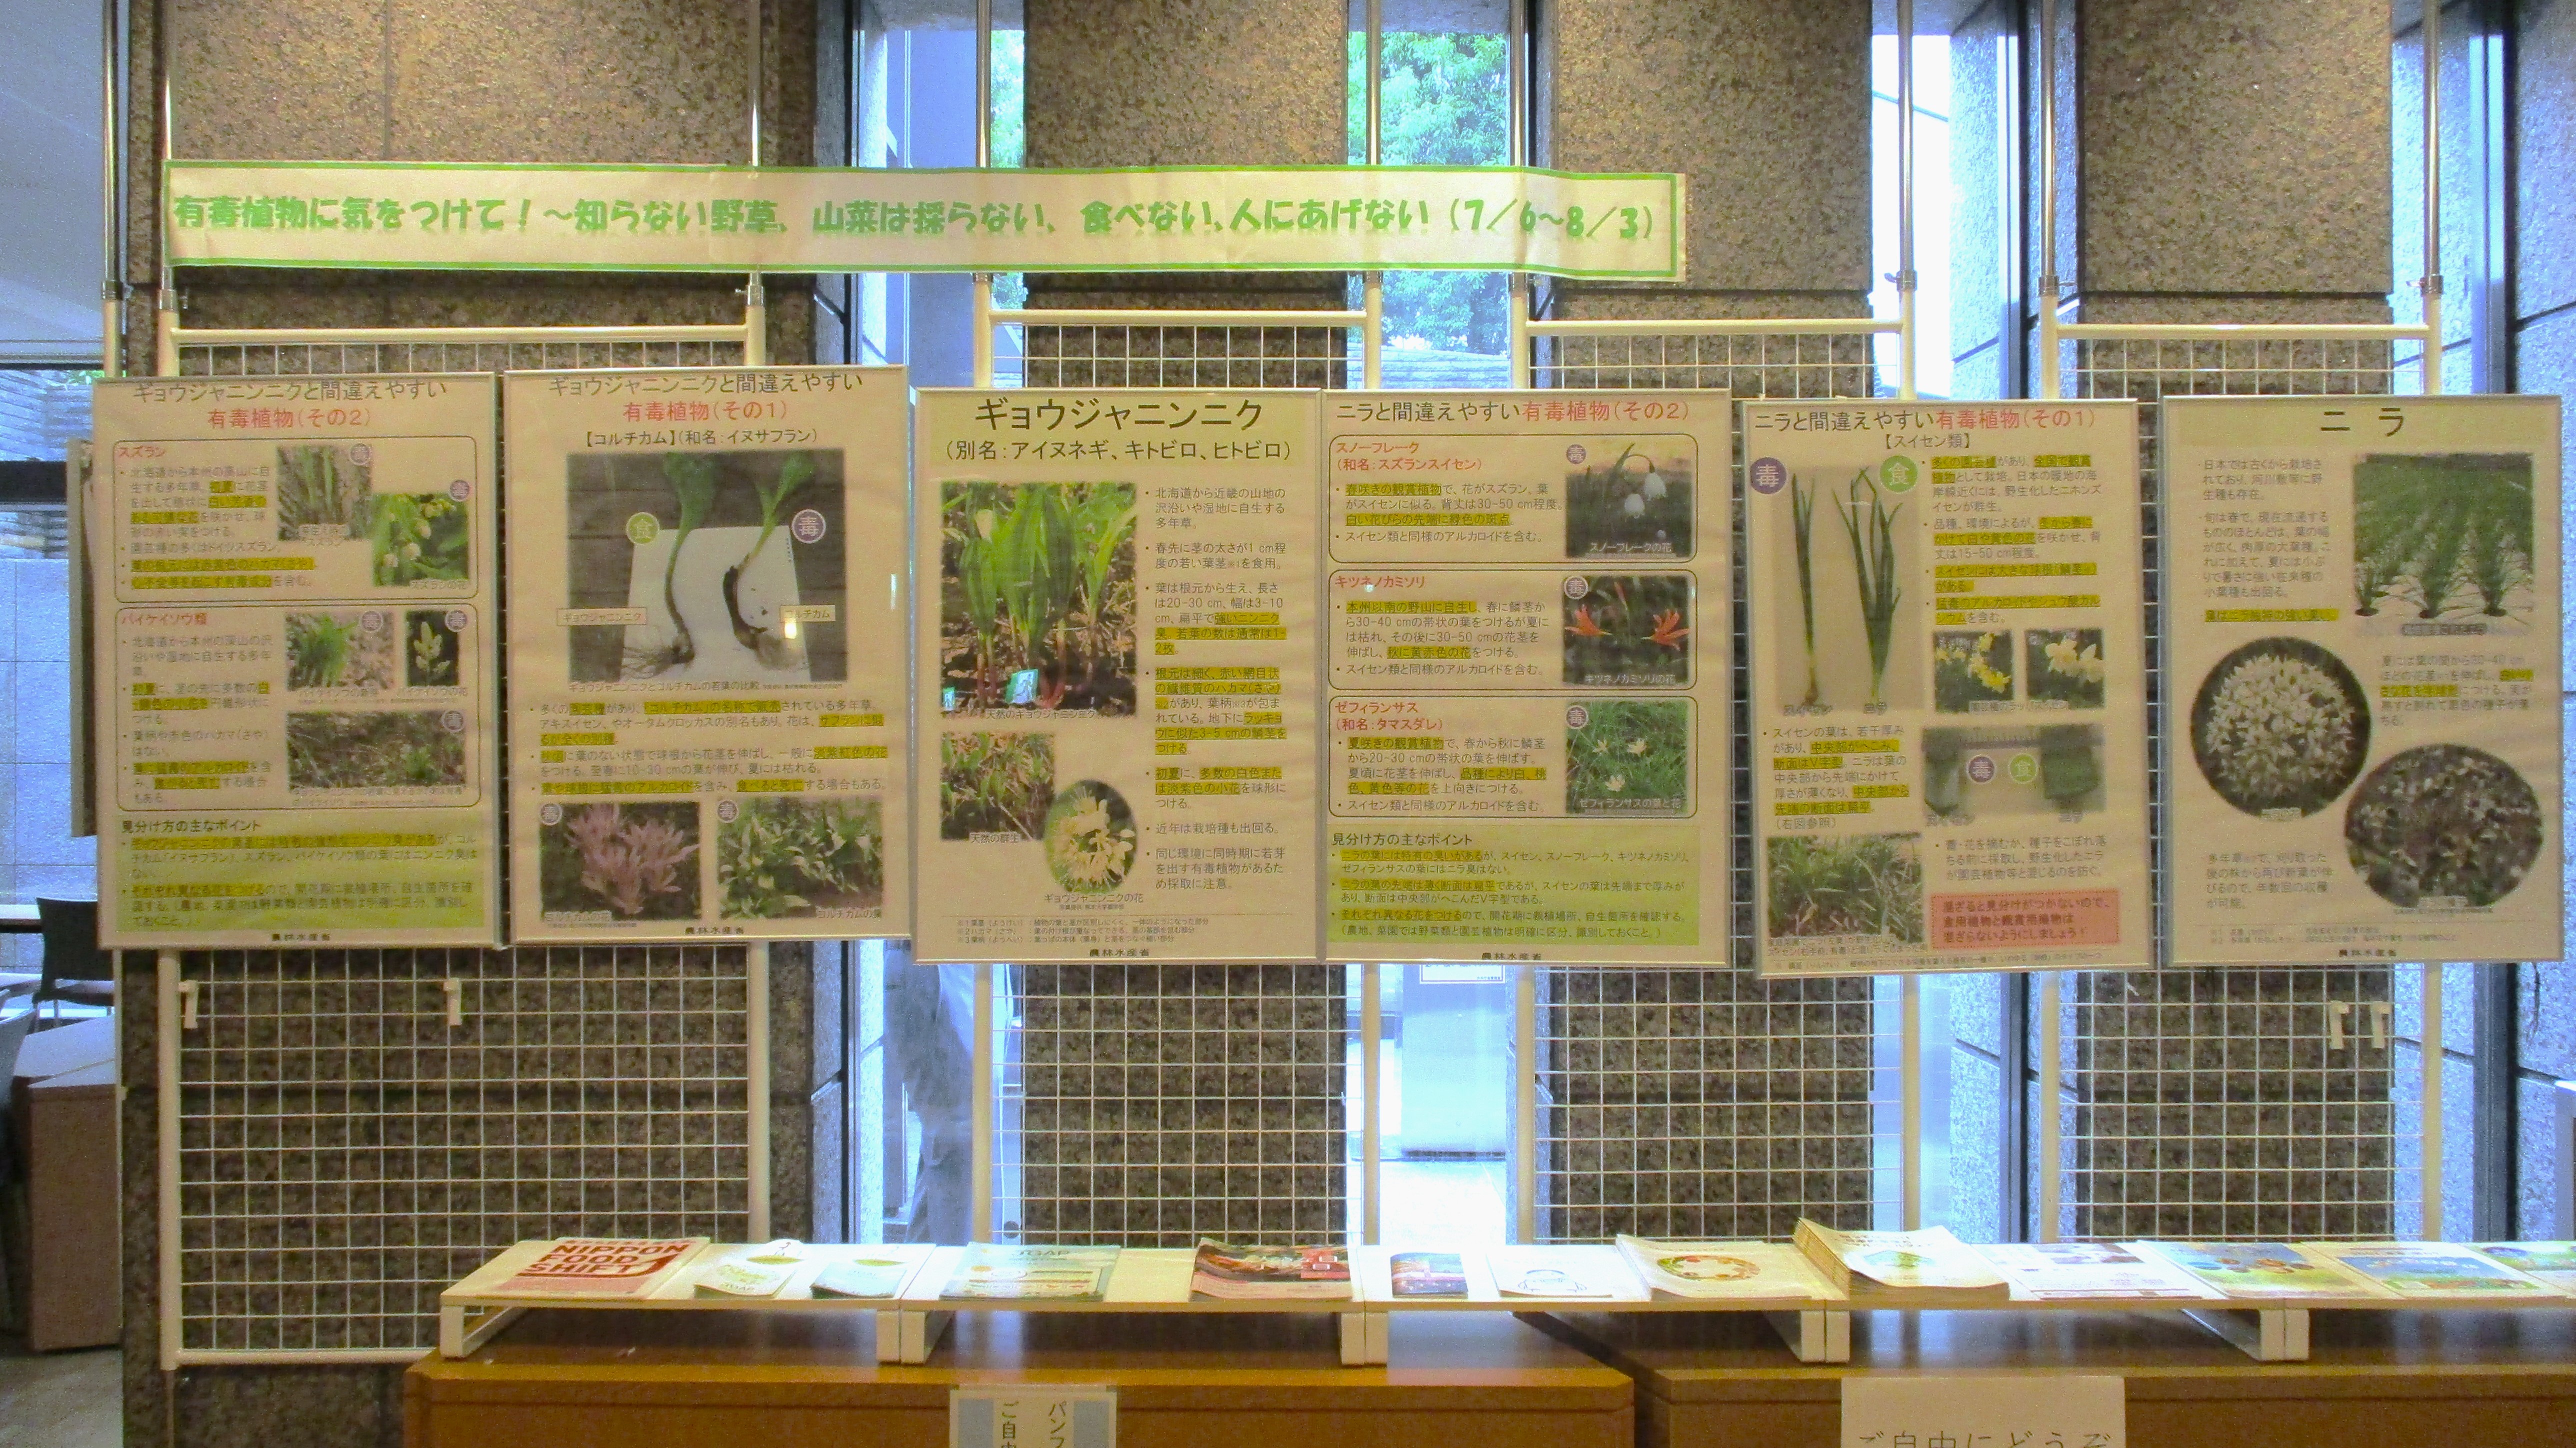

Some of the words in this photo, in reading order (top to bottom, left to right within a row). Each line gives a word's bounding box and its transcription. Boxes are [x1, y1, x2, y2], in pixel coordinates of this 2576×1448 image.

[550, 373, 862, 396] ギョウジャニンニクと間違えやすい
[133, 380, 448, 404] ギョウジャニンニクと間違えやすい
[623, 400, 788, 422] 有毒植物（その1）
[976, 398, 1264, 431] ギョウジャニンニク
[1336, 402, 1690, 424] ニラと間違えやすい有毒植物（その2）
[208, 408, 372, 430] 有毒植物（その2）
[1755, 409, 2095, 432] ニラと間違えやすい有毒植物（その1）
[2320, 408, 2406, 438] ニラ
[1336, 442, 1420, 454] スノーフレーク
[1886, 434, 1970, 450] 【スイセン類】
[119, 446, 166, 458] スズラン
[946, 440, 1291, 460] （別名：アイヌネギ、キトビロ、ヒトビロ）
[1569, 447, 1584, 462] 毒
[1338, 458, 1482, 472] （和名：スズランスイセン）
[1756, 464, 1780, 488] 毒
[1888, 463, 1911, 486] 食
[452, 482, 468, 499] 毒
[1156, 488, 1285, 500] 北海道から近畿の山地の
[1346, 484, 1549, 496] 春咲きの観賞植物で、花がスズラン、葉
[1156, 502, 1285, 514] 沢沿いや湿地に自生する
[799, 516, 820, 536] 毒
[1156, 518, 1198, 530] 多年草。
[1346, 514, 1514, 526] 白い花びらの先端に緑色の斑点。
[633, 520, 653, 539] 食
[1346, 531, 1544, 543] スイセン類と同様のアルカロイドを含む。
[1590, 542, 1672, 554] スノーフレークの花
[1156, 557, 1282, 570] 度の若い葉茎※1を食用。
[1336, 576, 1424, 588] キツネノカミソリ
[1569, 580, 1585, 596] 毒
[1156, 583, 1278, 595] 葉は根元から生え、長さ
[122, 613, 207, 626] バイケイソウ類
[562, 612, 642, 622] ギョウジャニンニク
[786, 609, 830, 620] コルチカム
[1156, 612, 1280, 625] cm、扁平で強いニンニク
[1347, 646, 1521, 659] 伸ばし、秋に黄赤色の花をつける。
[1156, 667, 1280, 680] 根元は細く、赤い網目状
[1346, 664, 1546, 676] スイセン類と同様のアルカロイドを含む。
[1586, 674, 1676, 685] キツネノカミソリの花
[1336, 702, 1419, 714] ゼフィランサス
[987, 711, 1096, 720] 天然のギョウジャニンニク
[1156, 712, 1283, 725] れている。地下にラッキョ
[1570, 710, 1584, 726] 毒
[1336, 718, 1444, 732] （和名：タマスダレ）
[1156, 743, 1192, 756] つける。
[1156, 767, 1282, 780] 初夏に、多数の白色また
[1156, 782, 1286, 795] は淡紫色の小花を球形に
[1156, 798, 1192, 810] つける。
[1348, 800, 1546, 813] スイセン類と同様のアルカロイドを含む。
[122, 820, 261, 833] 見分け方の主なポイント
[1156, 822, 1281, 835] 近年は栽培種も出回る。
[972, 833, 1019, 844] 天然の群生
[1332, 834, 1473, 846] 見分け方の主なポイント
[1156, 847, 1286, 860] 同じ環境に同時期に若芽
[1156, 862, 1284, 875] を出す有毒植物があるた
[1156, 878, 1234, 890] め採取に注意。
[1044, 893, 1144, 904] ギョウジャニンニクの花
[1090, 949, 1150, 957] 農林水産省
[552, 1244, 690, 1254] NIPPON
[540, 1254, 640, 1264] FOOD
[525, 1264, 640, 1274] SHIFT
